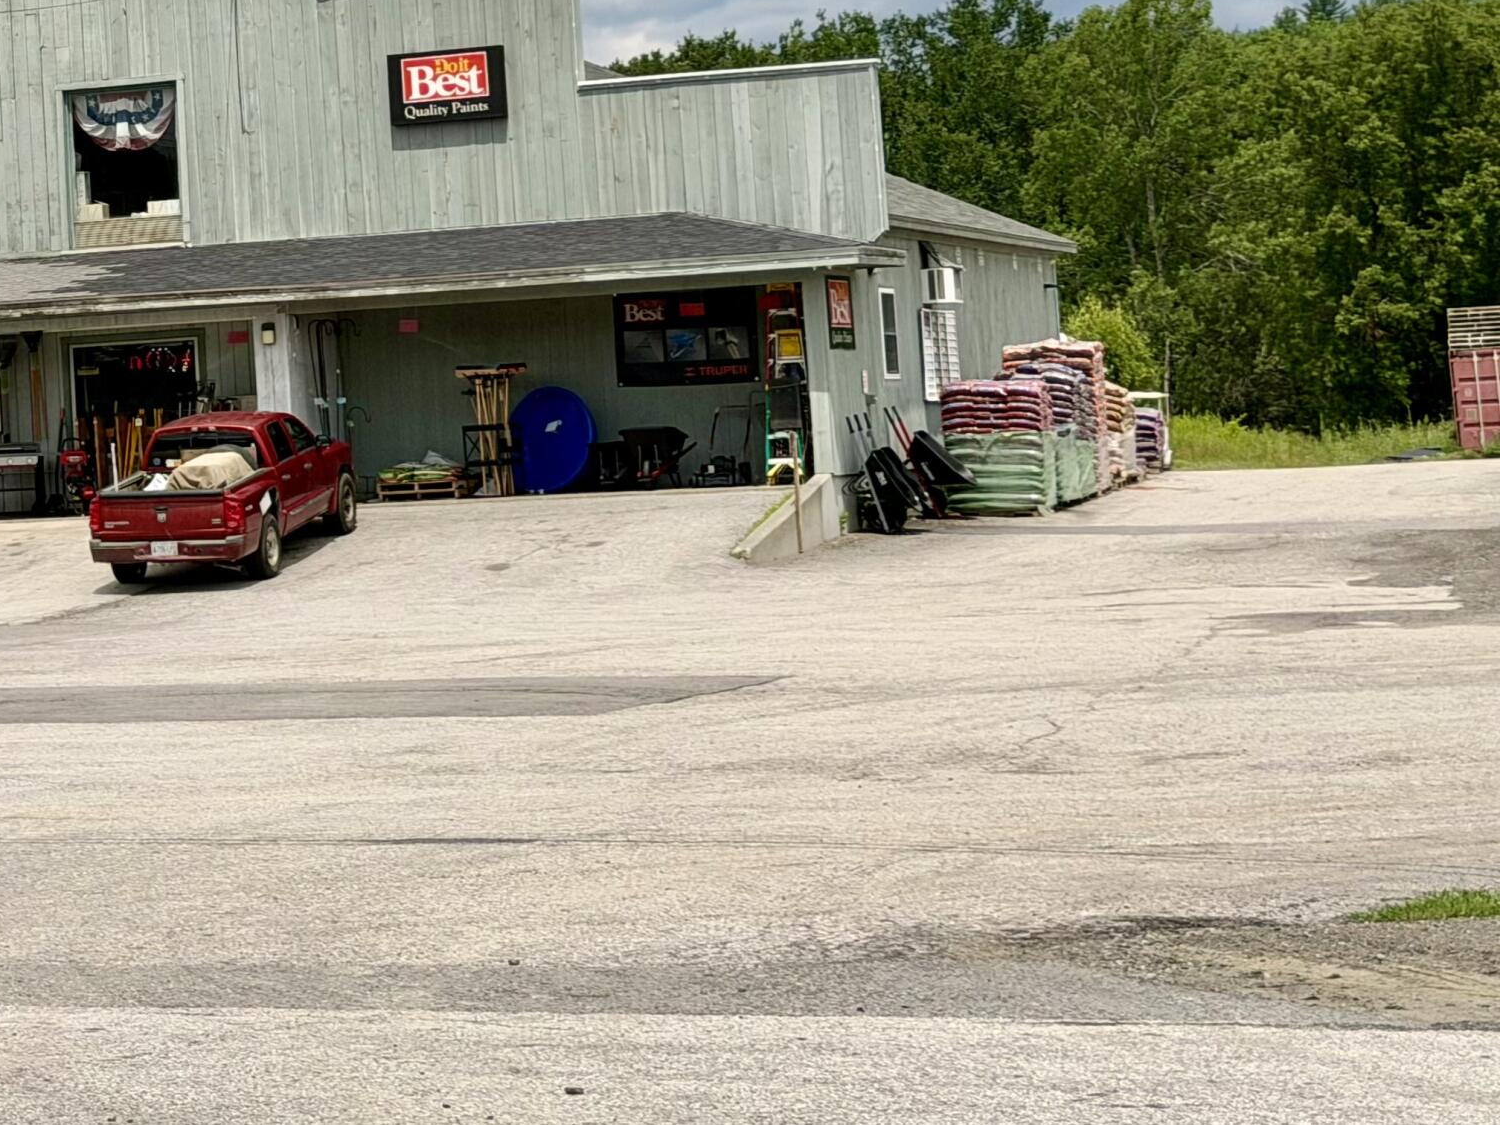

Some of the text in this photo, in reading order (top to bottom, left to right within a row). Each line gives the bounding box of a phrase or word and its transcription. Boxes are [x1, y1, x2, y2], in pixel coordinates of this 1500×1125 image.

[435, 57, 471, 74] Do it
[406, 64, 485, 100] Best
[404, 101, 489, 119] Quality Paints
[623, 303, 665, 322] Best
[698, 365, 748, 376] TRUPER
